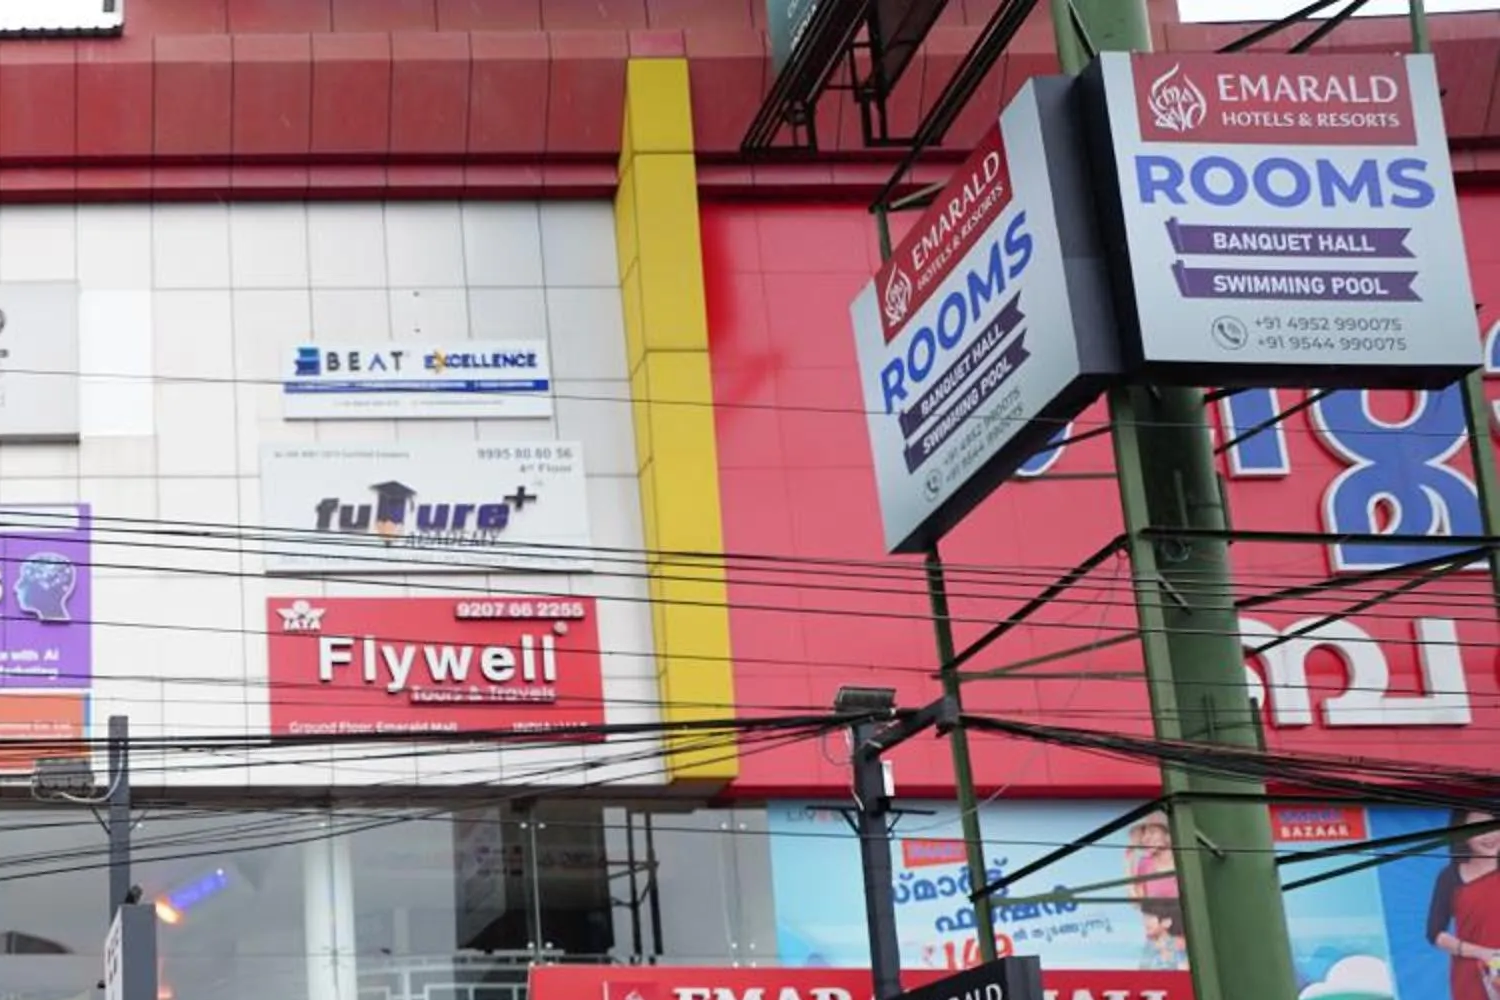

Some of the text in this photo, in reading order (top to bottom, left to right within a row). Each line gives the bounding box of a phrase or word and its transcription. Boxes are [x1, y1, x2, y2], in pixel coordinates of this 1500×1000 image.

[1217, 74, 1398, 103] EMARALD
[1222, 111, 1400, 128] HOTELS & RESORTS
[1135, 154, 1435, 208] ROOMS
[912, 151, 999, 270] EMARALD
[1213, 233, 1375, 253] BANQUET HALL
[1213, 275, 1389, 295] SWIMMING POOL
[881, 211, 1033, 414] ROOMS
[1255, 317, 1403, 332] +91 4952 990075
[971, 323, 1004, 363] HALL
[1257, 337, 1407, 351] +91 9544 990075
[326, 351, 404, 371] BEAT
[980, 357, 1013, 396] POOL
[319, 634, 557, 692] Flywell
[1280, 825, 1350, 839] BAZAAR
